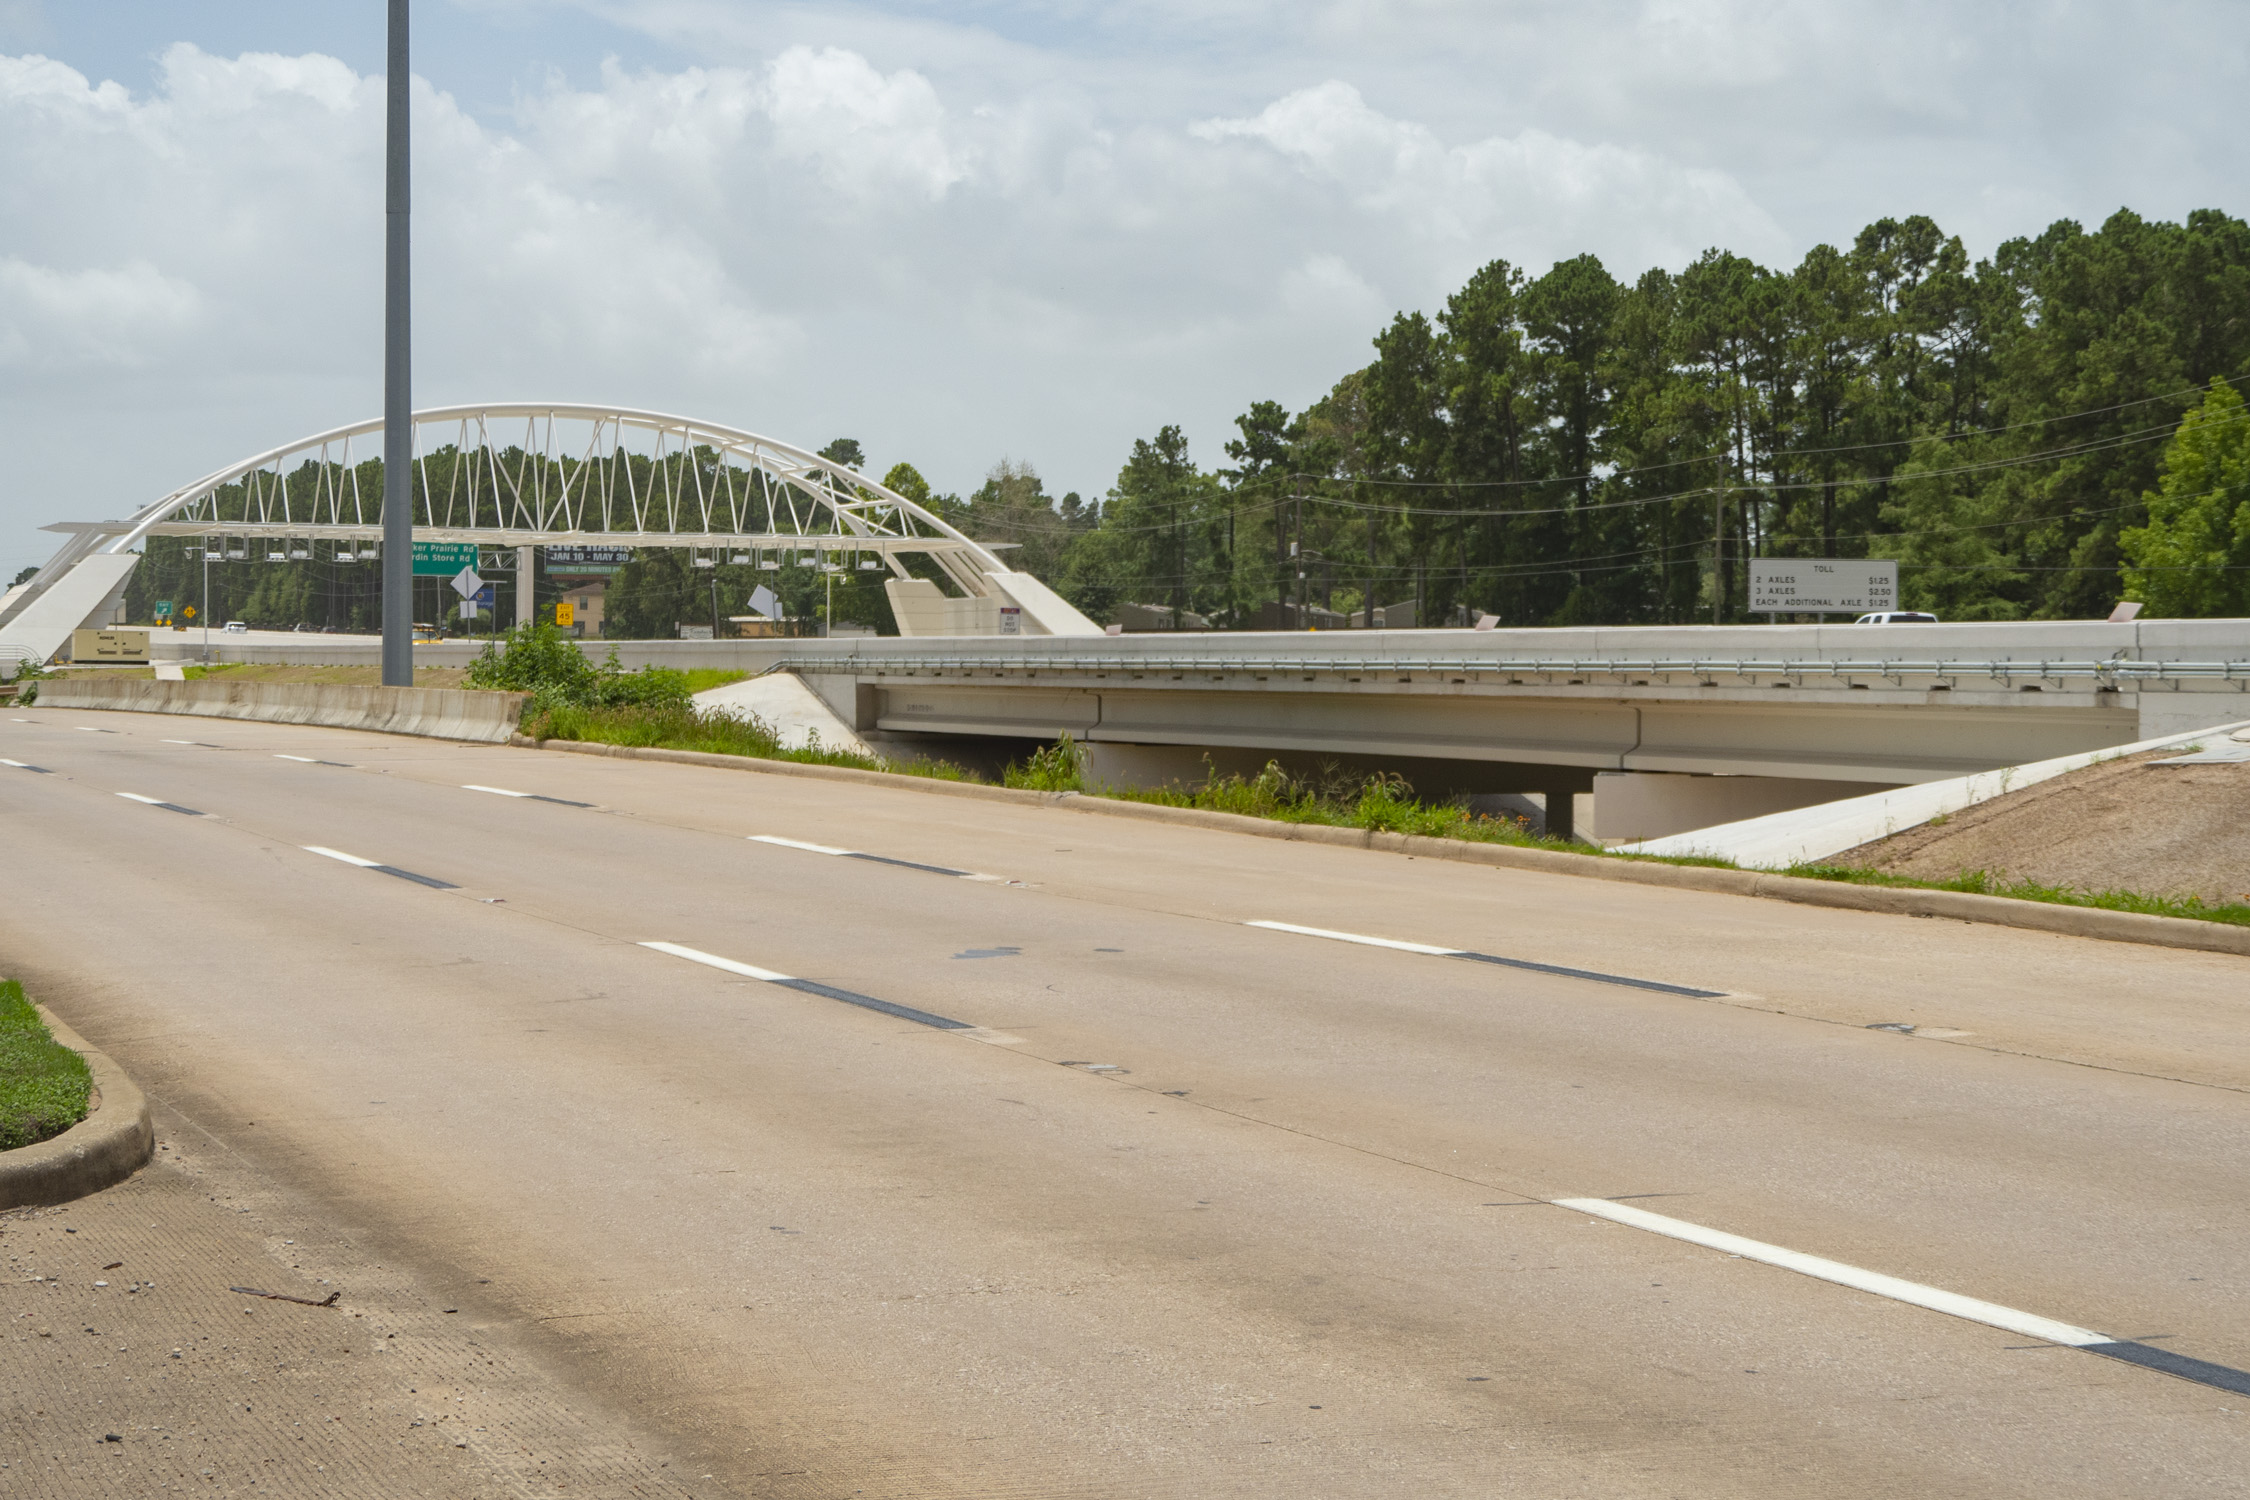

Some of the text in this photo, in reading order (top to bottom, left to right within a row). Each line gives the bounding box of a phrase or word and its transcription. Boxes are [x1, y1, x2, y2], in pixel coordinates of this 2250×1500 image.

[551, 552, 570, 560] JAN
[573, 553, 584, 561] 10
[593, 553, 614, 561] MAY
[616, 553, 629, 561] 30
